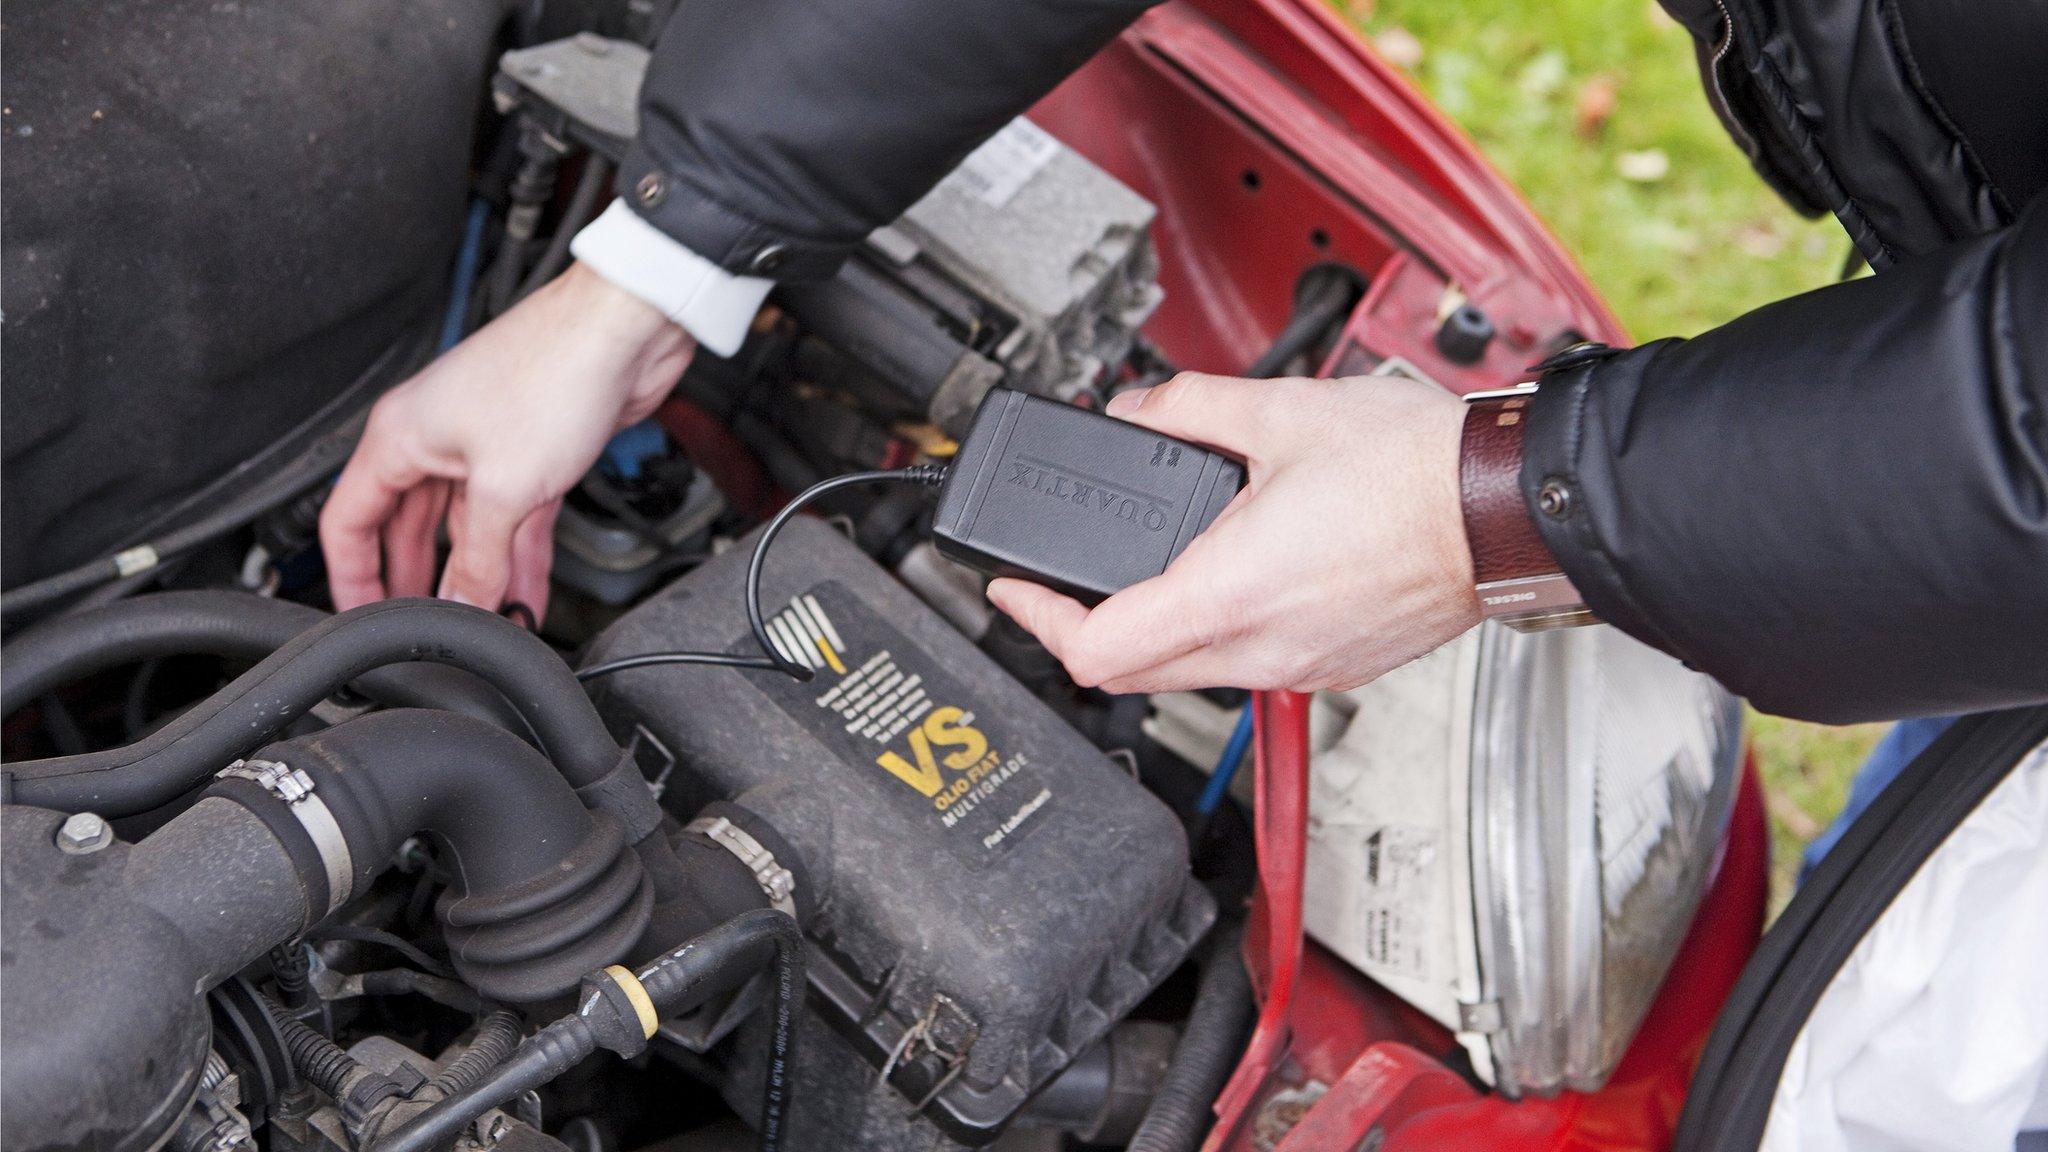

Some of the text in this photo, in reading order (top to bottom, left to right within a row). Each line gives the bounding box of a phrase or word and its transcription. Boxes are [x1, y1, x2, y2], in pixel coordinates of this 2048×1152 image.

[1007, 462, 1169, 532] QUARTIX
[876, 705, 988, 798] VS
[934, 751, 1000, 811] OLIO FIAT
[941, 752, 1029, 827] MULTIGRADE
